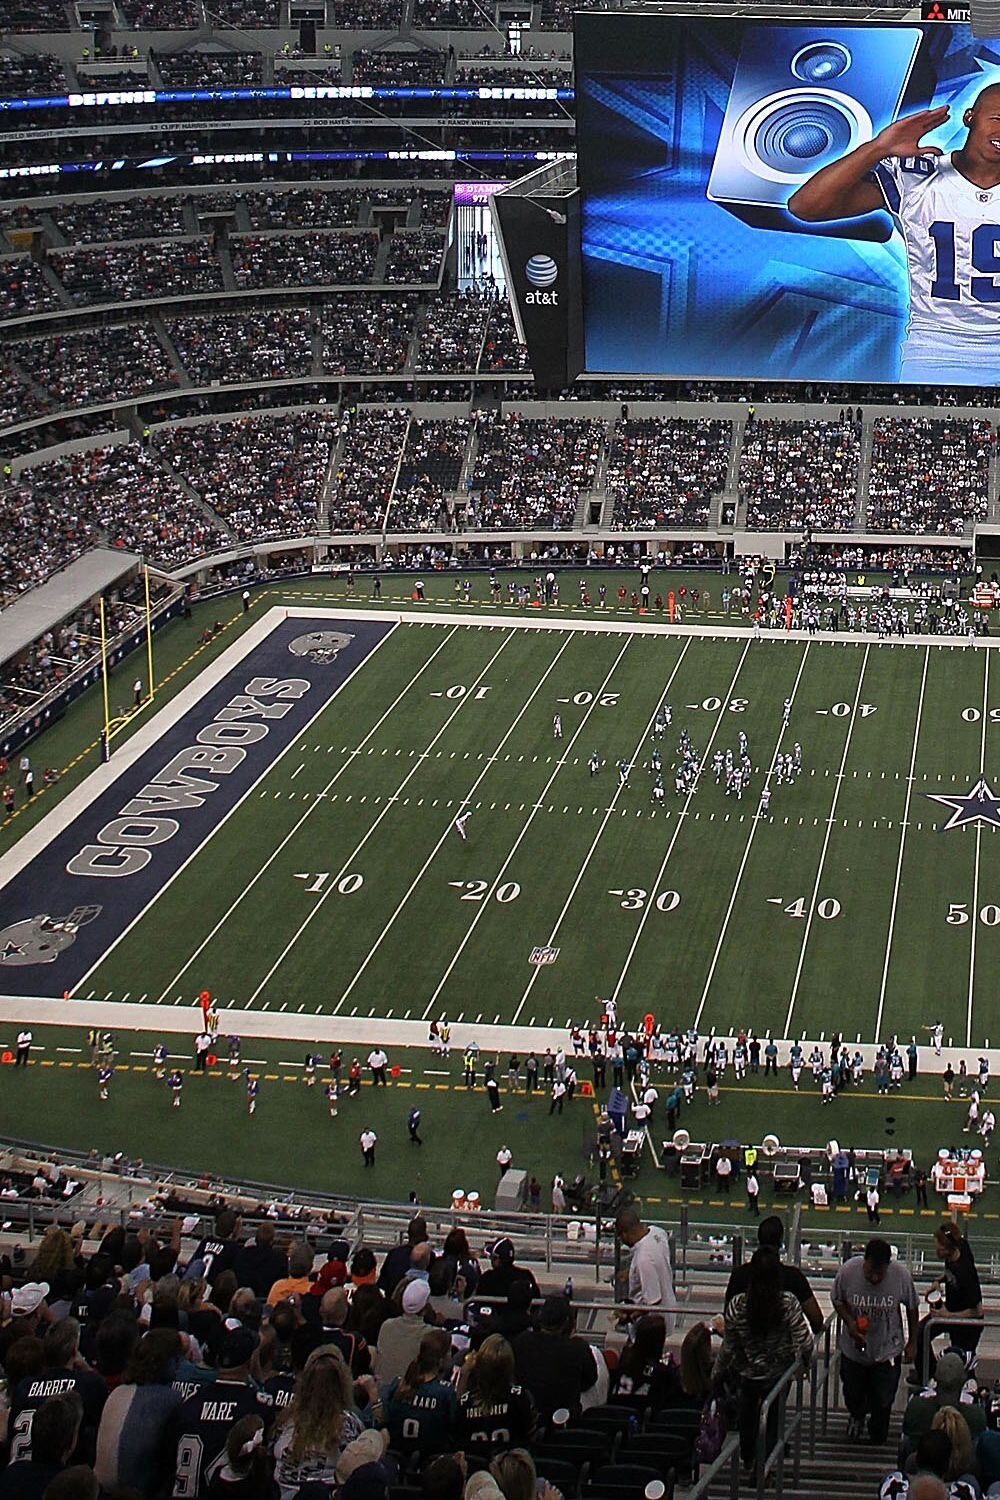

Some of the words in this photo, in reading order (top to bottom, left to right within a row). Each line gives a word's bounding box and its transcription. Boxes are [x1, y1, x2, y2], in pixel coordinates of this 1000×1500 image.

[68, 90, 157, 107] DEFENSE
[291, 86, 373, 99] DEFENSE
[478, 87, 558, 100] DEFENSE
[192, 153, 264, 165] DEFENSE
[0, 163, 61, 178] EFENSE
[525, 289, 559, 306] at&t
[65, 676, 312, 878] COWBOYS
[304, 871, 365, 895] 10
[460, 879, 522, 904] 20
[619, 887, 682, 912] 30
[783, 896, 842, 920] 40
[852, 1293, 894, 1307] DALLAS
[27, 1378, 77, 1398] BARBER
[413, 1395, 437, 1409] RARD
[200, 1401, 238, 1421] WARE
